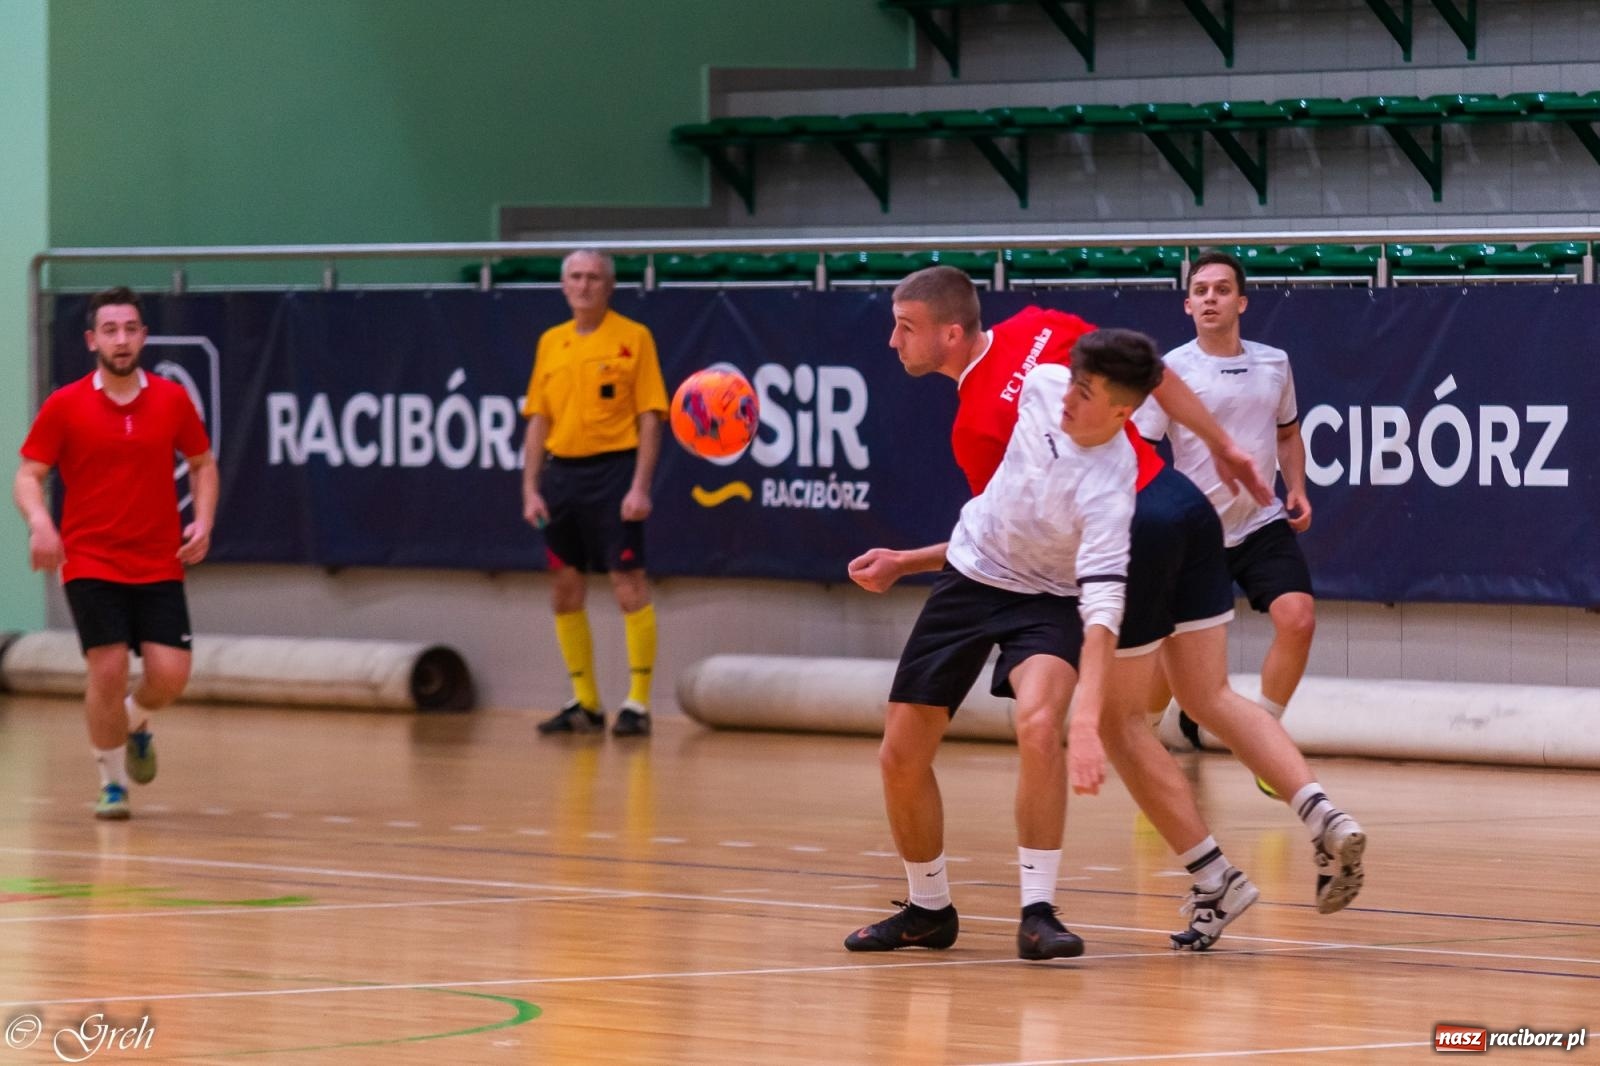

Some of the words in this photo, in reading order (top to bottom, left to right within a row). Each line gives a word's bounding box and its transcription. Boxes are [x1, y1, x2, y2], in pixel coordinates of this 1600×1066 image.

[1000, 380, 1021, 402] FC
[1276, 373, 1569, 488] CIBÓRZ
[762, 472, 870, 510] RACIBÓRZ
